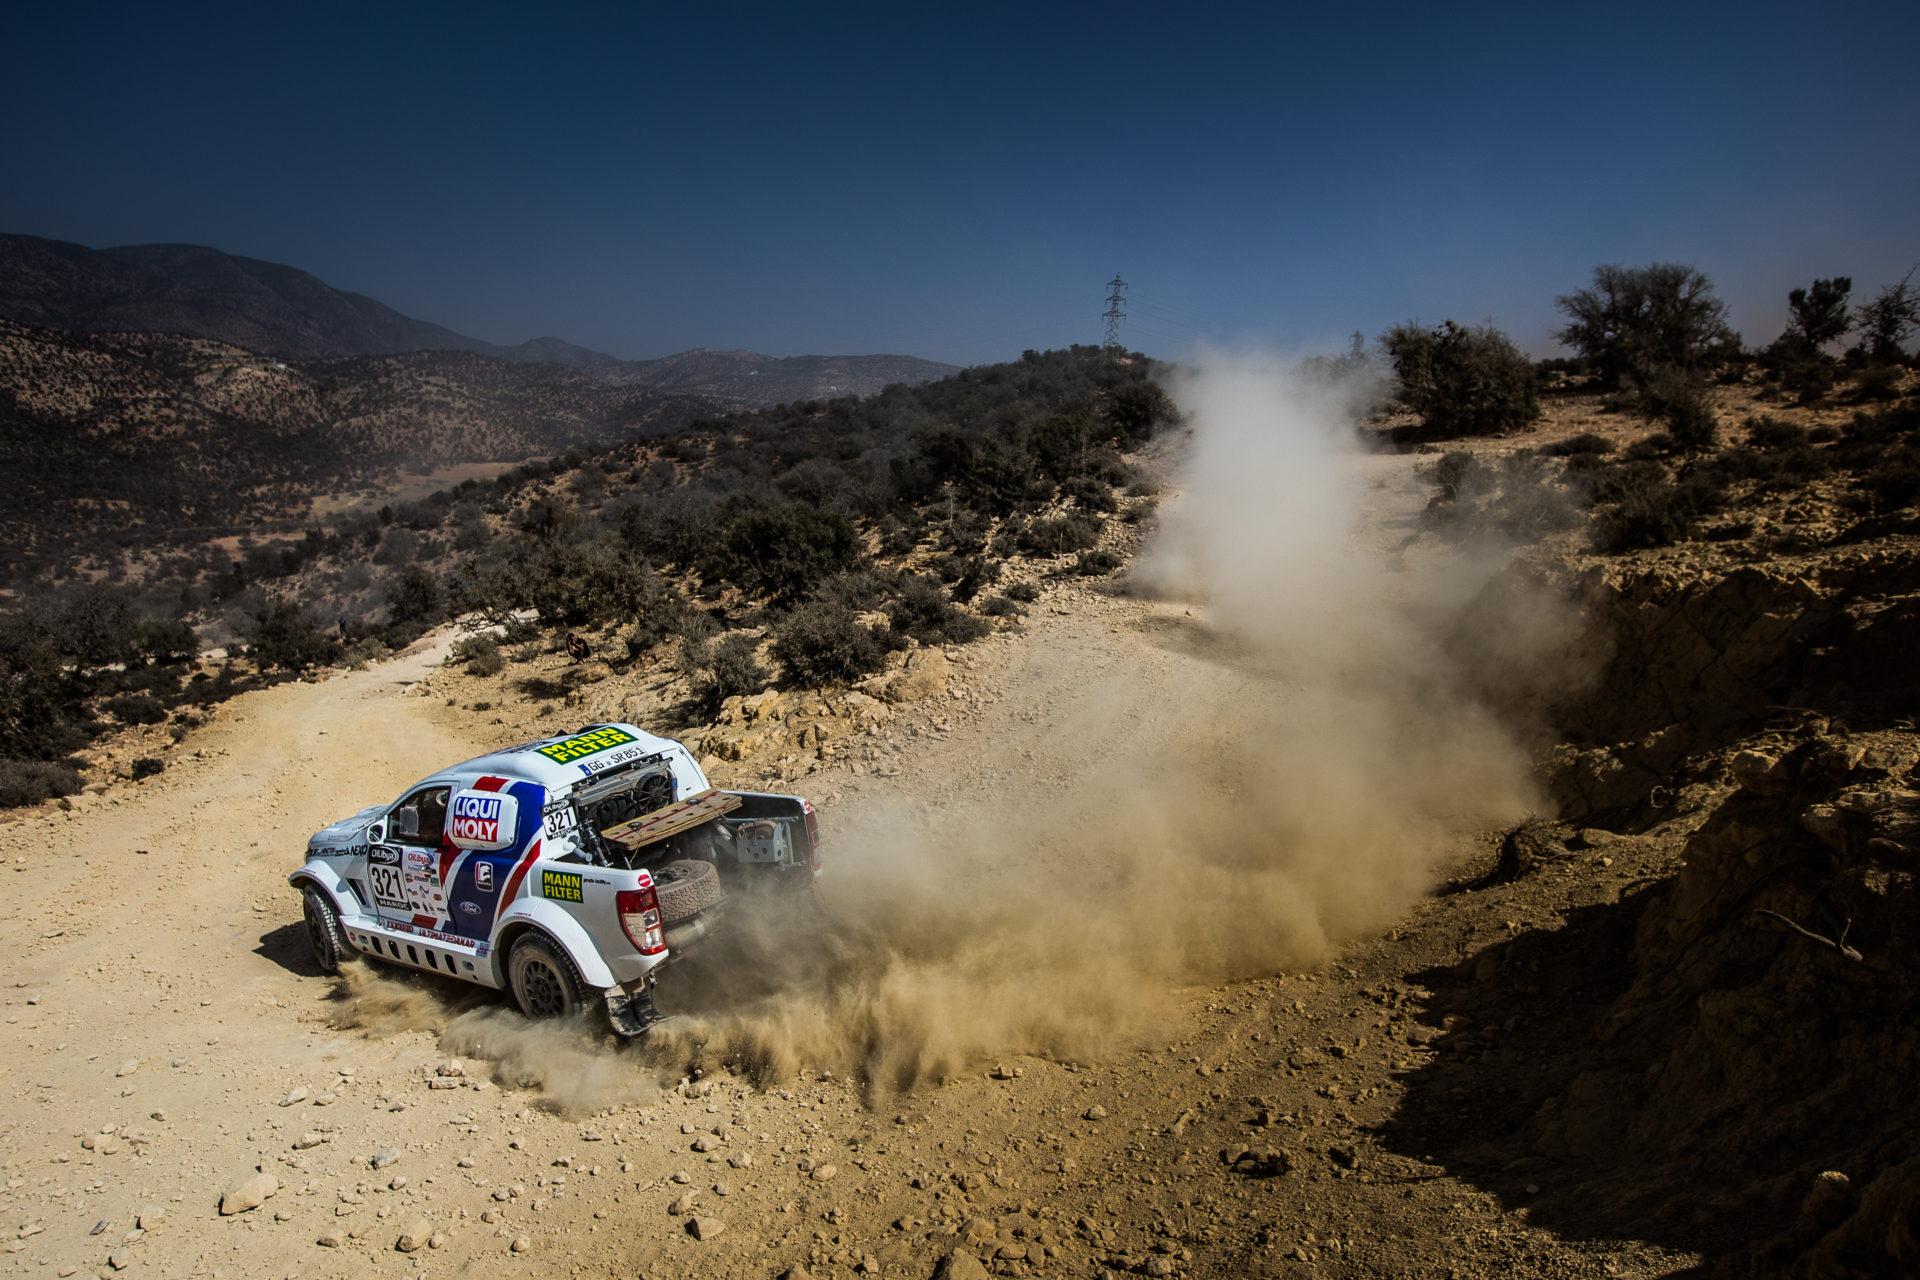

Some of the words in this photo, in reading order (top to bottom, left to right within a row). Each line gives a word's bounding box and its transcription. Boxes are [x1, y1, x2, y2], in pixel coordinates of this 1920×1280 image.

[540, 727, 618, 755] MANN
[552, 733, 631, 762] FILTER
[587, 760, 605, 772] GG
[455, 798, 499, 820] LIQUI
[453, 818, 498, 841] MOLY
[547, 809, 573, 833] 321
[371, 866, 404, 900] 321
[544, 872, 580, 889] MANN
[544, 885, 581, 901] FILTER
[380, 899, 410, 911] MAROC
